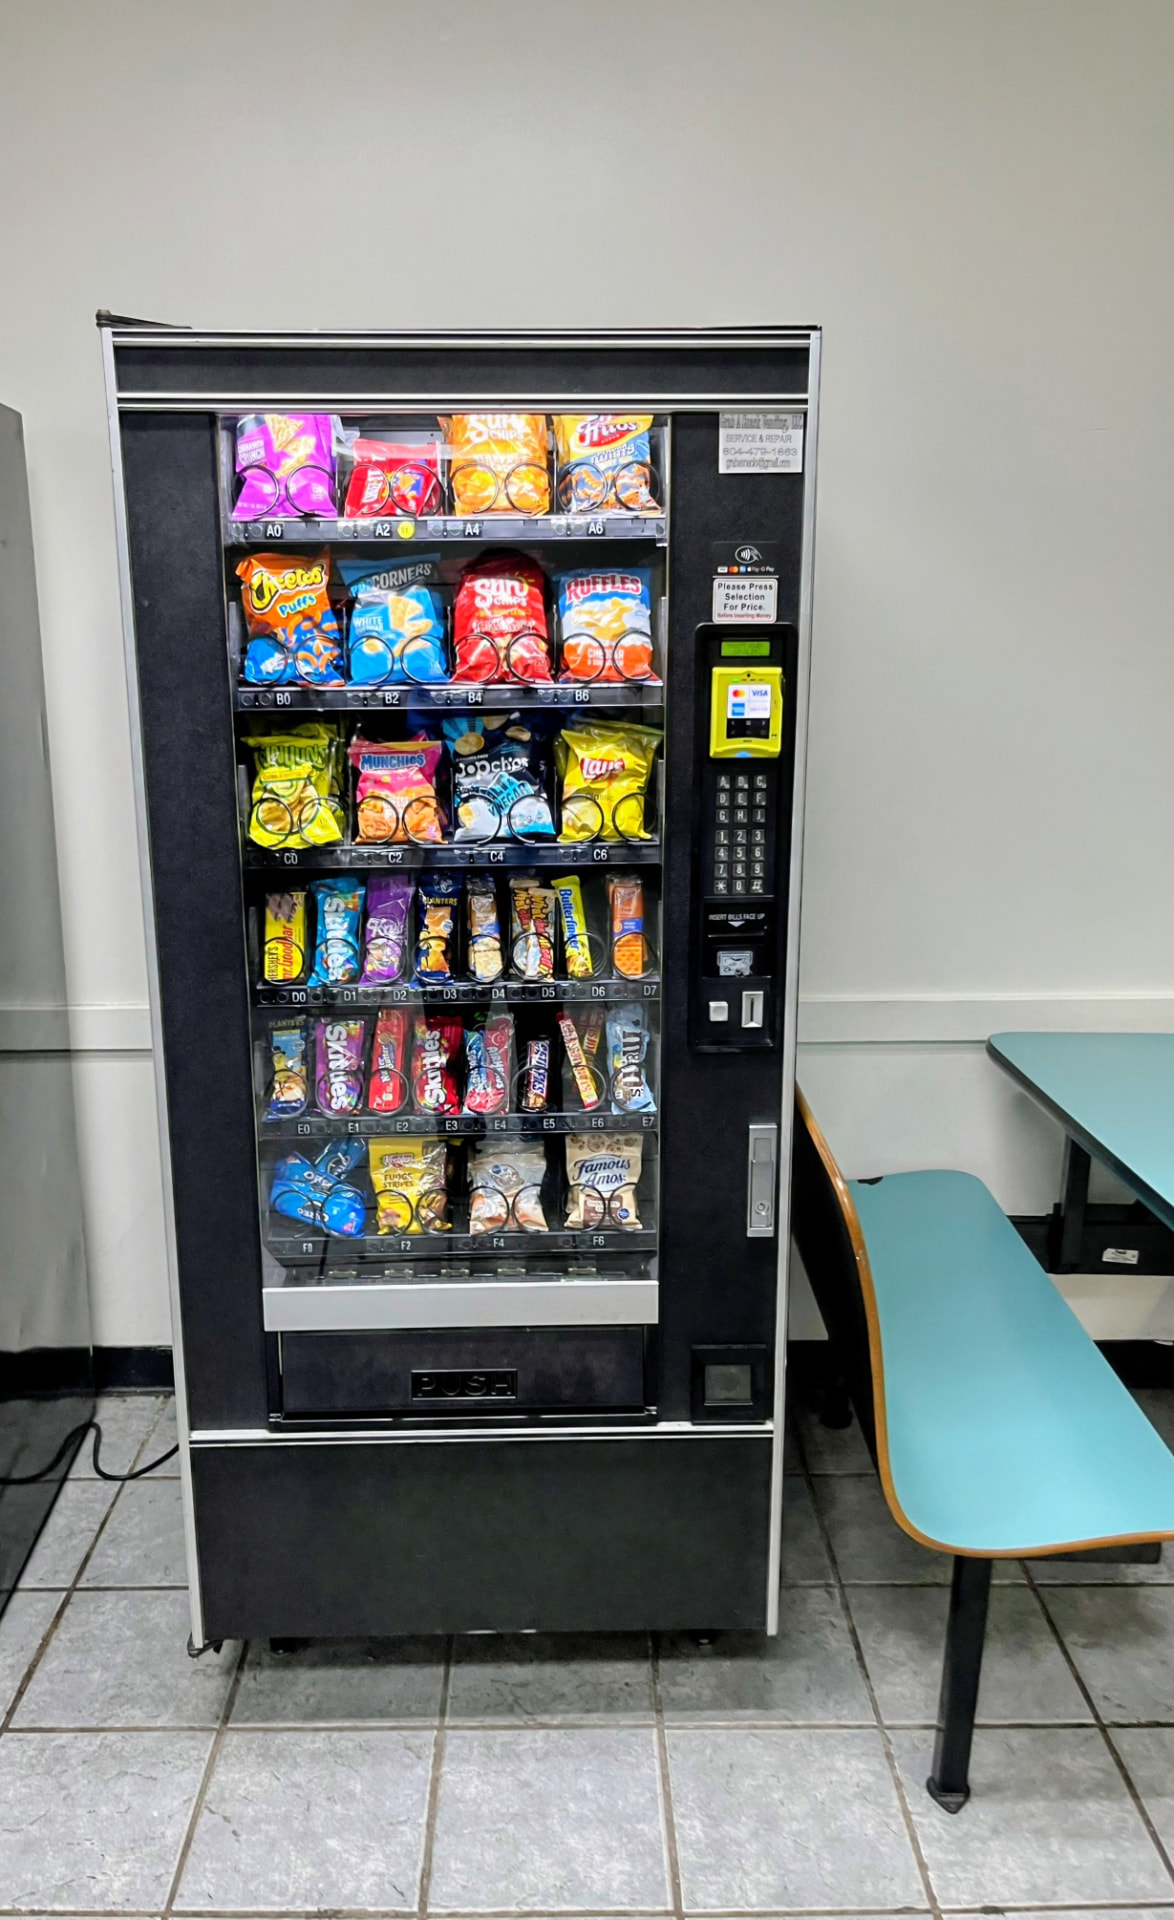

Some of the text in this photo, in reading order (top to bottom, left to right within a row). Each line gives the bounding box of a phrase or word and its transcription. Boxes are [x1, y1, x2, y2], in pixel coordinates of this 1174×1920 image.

[726, 434, 757, 443] SERVICE
[765, 434, 792, 443] REPAIR
[266, 524, 282, 537] A0
[375, 524, 390, 537] A2
[465, 523, 480, 536] A4
[588, 522, 604, 535] A6
[250, 565, 324, 610] Cheetos
[566, 573, 642, 602] RUFFLES
[717, 582, 773, 591] Please Press
[474, 578, 529, 609] Sun
[725, 592, 765, 601] Selection
[279, 594, 317, 617] Puffs
[494, 597, 528, 606] CHIPS
[723, 603, 738, 611] For
[276, 692, 291, 705] B0
[384, 692, 400, 704] B2
[467, 691, 483, 703] B4
[575, 689, 590, 702] B6
[719, 776, 727, 787] A
[756, 776, 763, 786] C
[720, 793, 762, 804] D E F
[719, 809, 726, 821] G
[737, 809, 744, 820] H
[720, 831, 761, 841] 1 2 3
[283, 852, 298, 864] C0
[388, 851, 403, 863] C2
[490, 851, 504, 862] C4
[593, 848, 608, 861] C6
[718, 847, 761, 858] 4 5 6
[719, 864, 760, 874] 7 8 9
[736, 881, 742, 891] 0
[727, 913, 743, 921] BILLS
[757, 912, 765, 920] UP
[343, 991, 356, 1001] D1
[393, 990, 407, 1001] D2
[443, 989, 457, 1000] D3
[491, 988, 506, 999] D4
[541, 987, 555, 998] D5
[591, 986, 606, 997] D6
[643, 985, 657, 996] D7
[292, 992, 306, 1002] D0
[348, 1122, 360, 1132] E1
[396, 1121, 409, 1131] E2
[445, 1120, 458, 1130] E3
[494, 1119, 506, 1129] E4
[543, 1118, 555, 1129] E5
[591, 1118, 604, 1128] E6
[642, 1116, 655, 1127] E7
[297, 1124, 310, 1134] E0
[572, 1159, 631, 1182] Famous
[383, 1180, 414, 1189] STRIPES
[400, 1240, 412, 1251] F2
[493, 1238, 505, 1247] F4
[592, 1236, 605, 1246] F6
[303, 1243, 313, 1253] F0
[417, 1375, 512, 1396] PUSH
